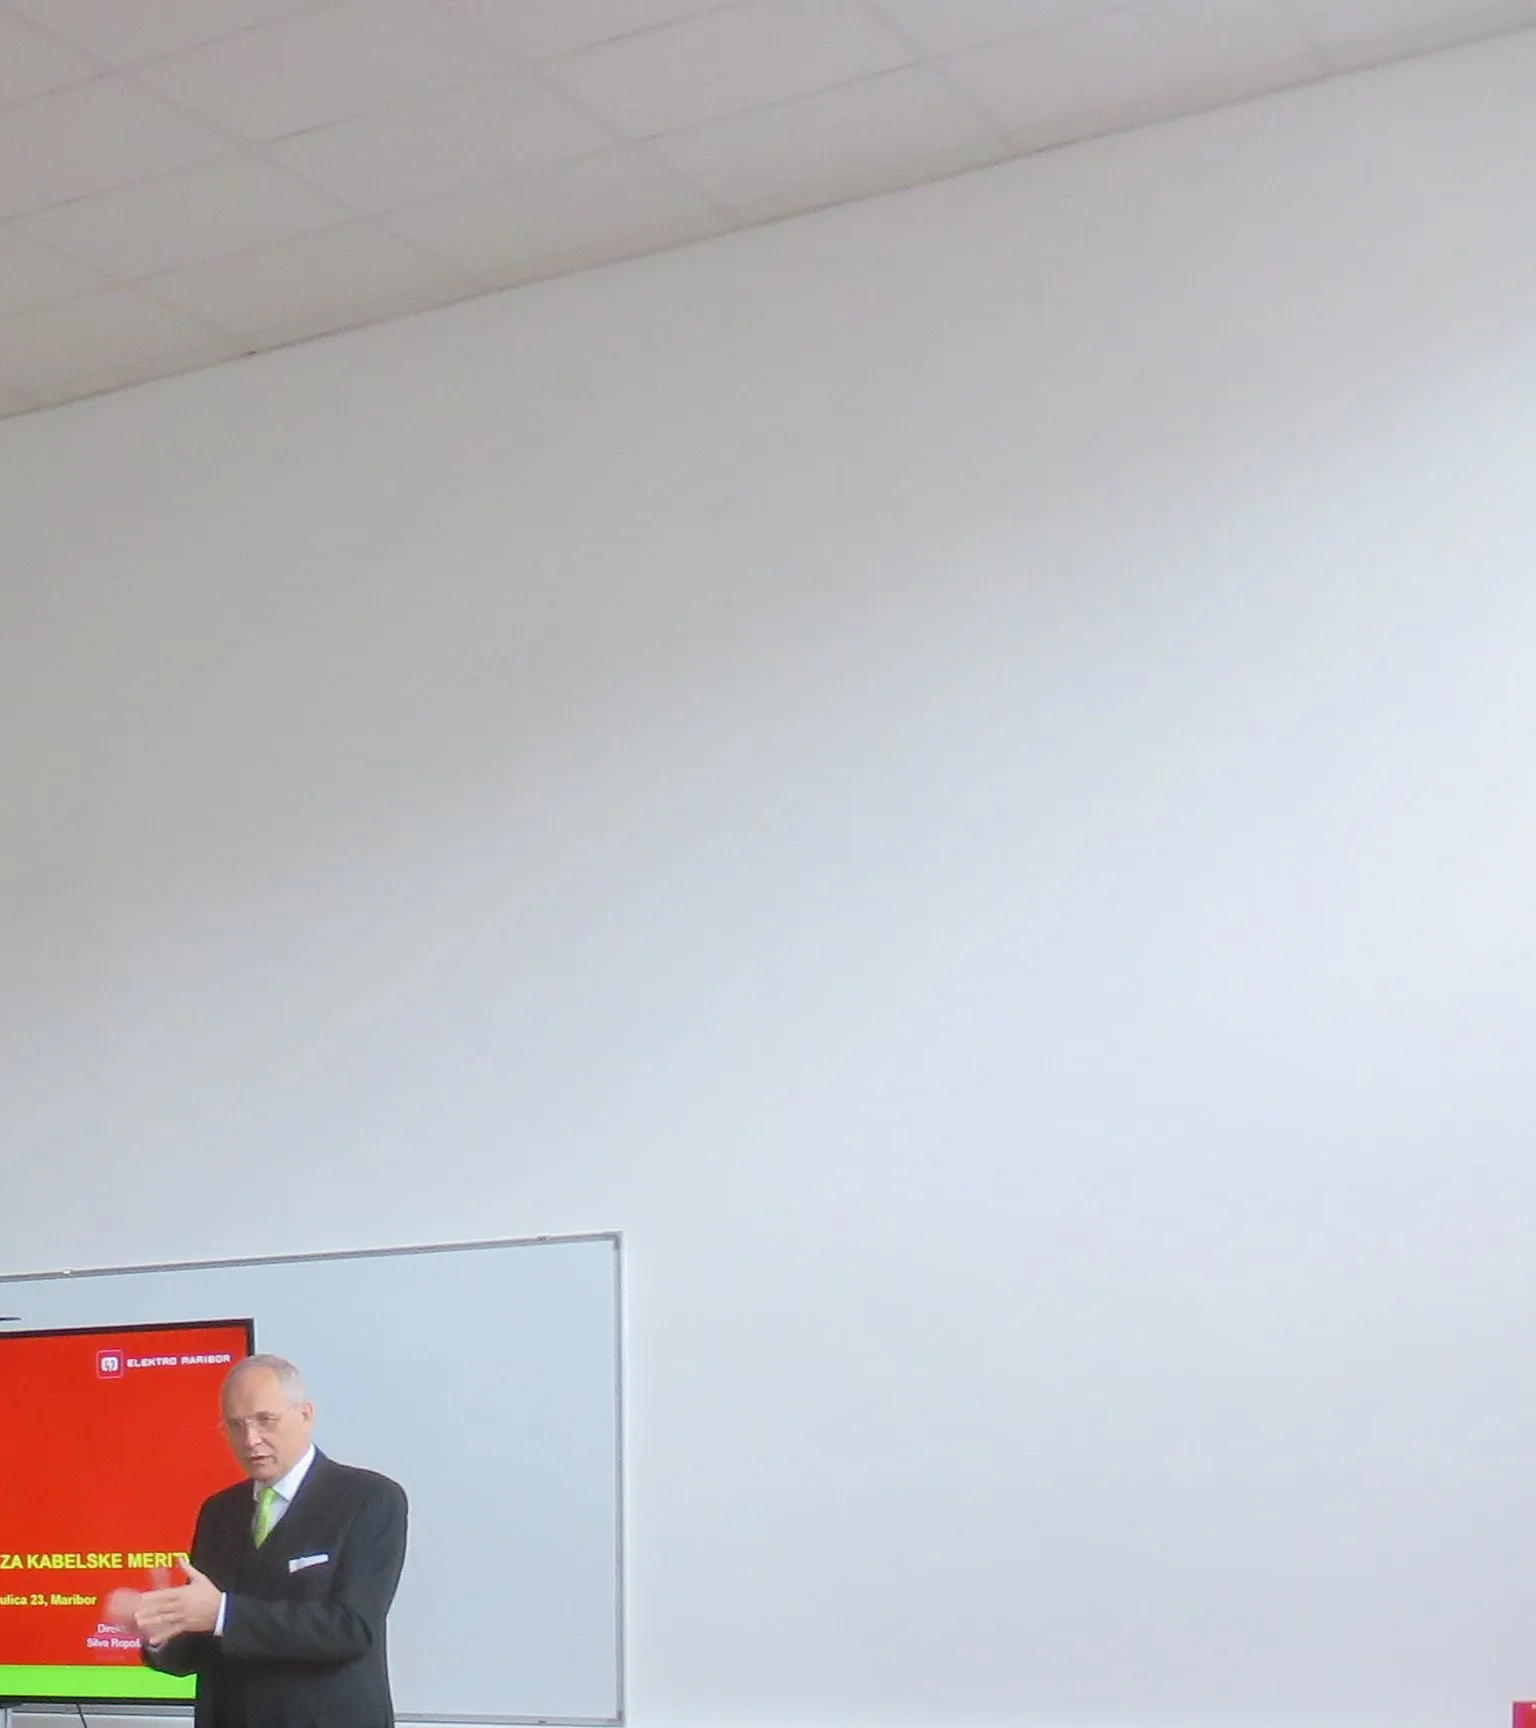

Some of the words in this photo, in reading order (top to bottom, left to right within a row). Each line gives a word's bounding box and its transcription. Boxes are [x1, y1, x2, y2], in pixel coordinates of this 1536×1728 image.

[126, 1356, 177, 1368] ELEKTRO
[180, 1354, 231, 1366] MARIBOR
[0, 1552, 24, 1570] ZA
[27, 1552, 123, 1570] KABELSKE
[0, 1593, 28, 1606] ulica
[30, 1594, 48, 1608] 23,
[50, 1593, 98, 1606] Maribor
